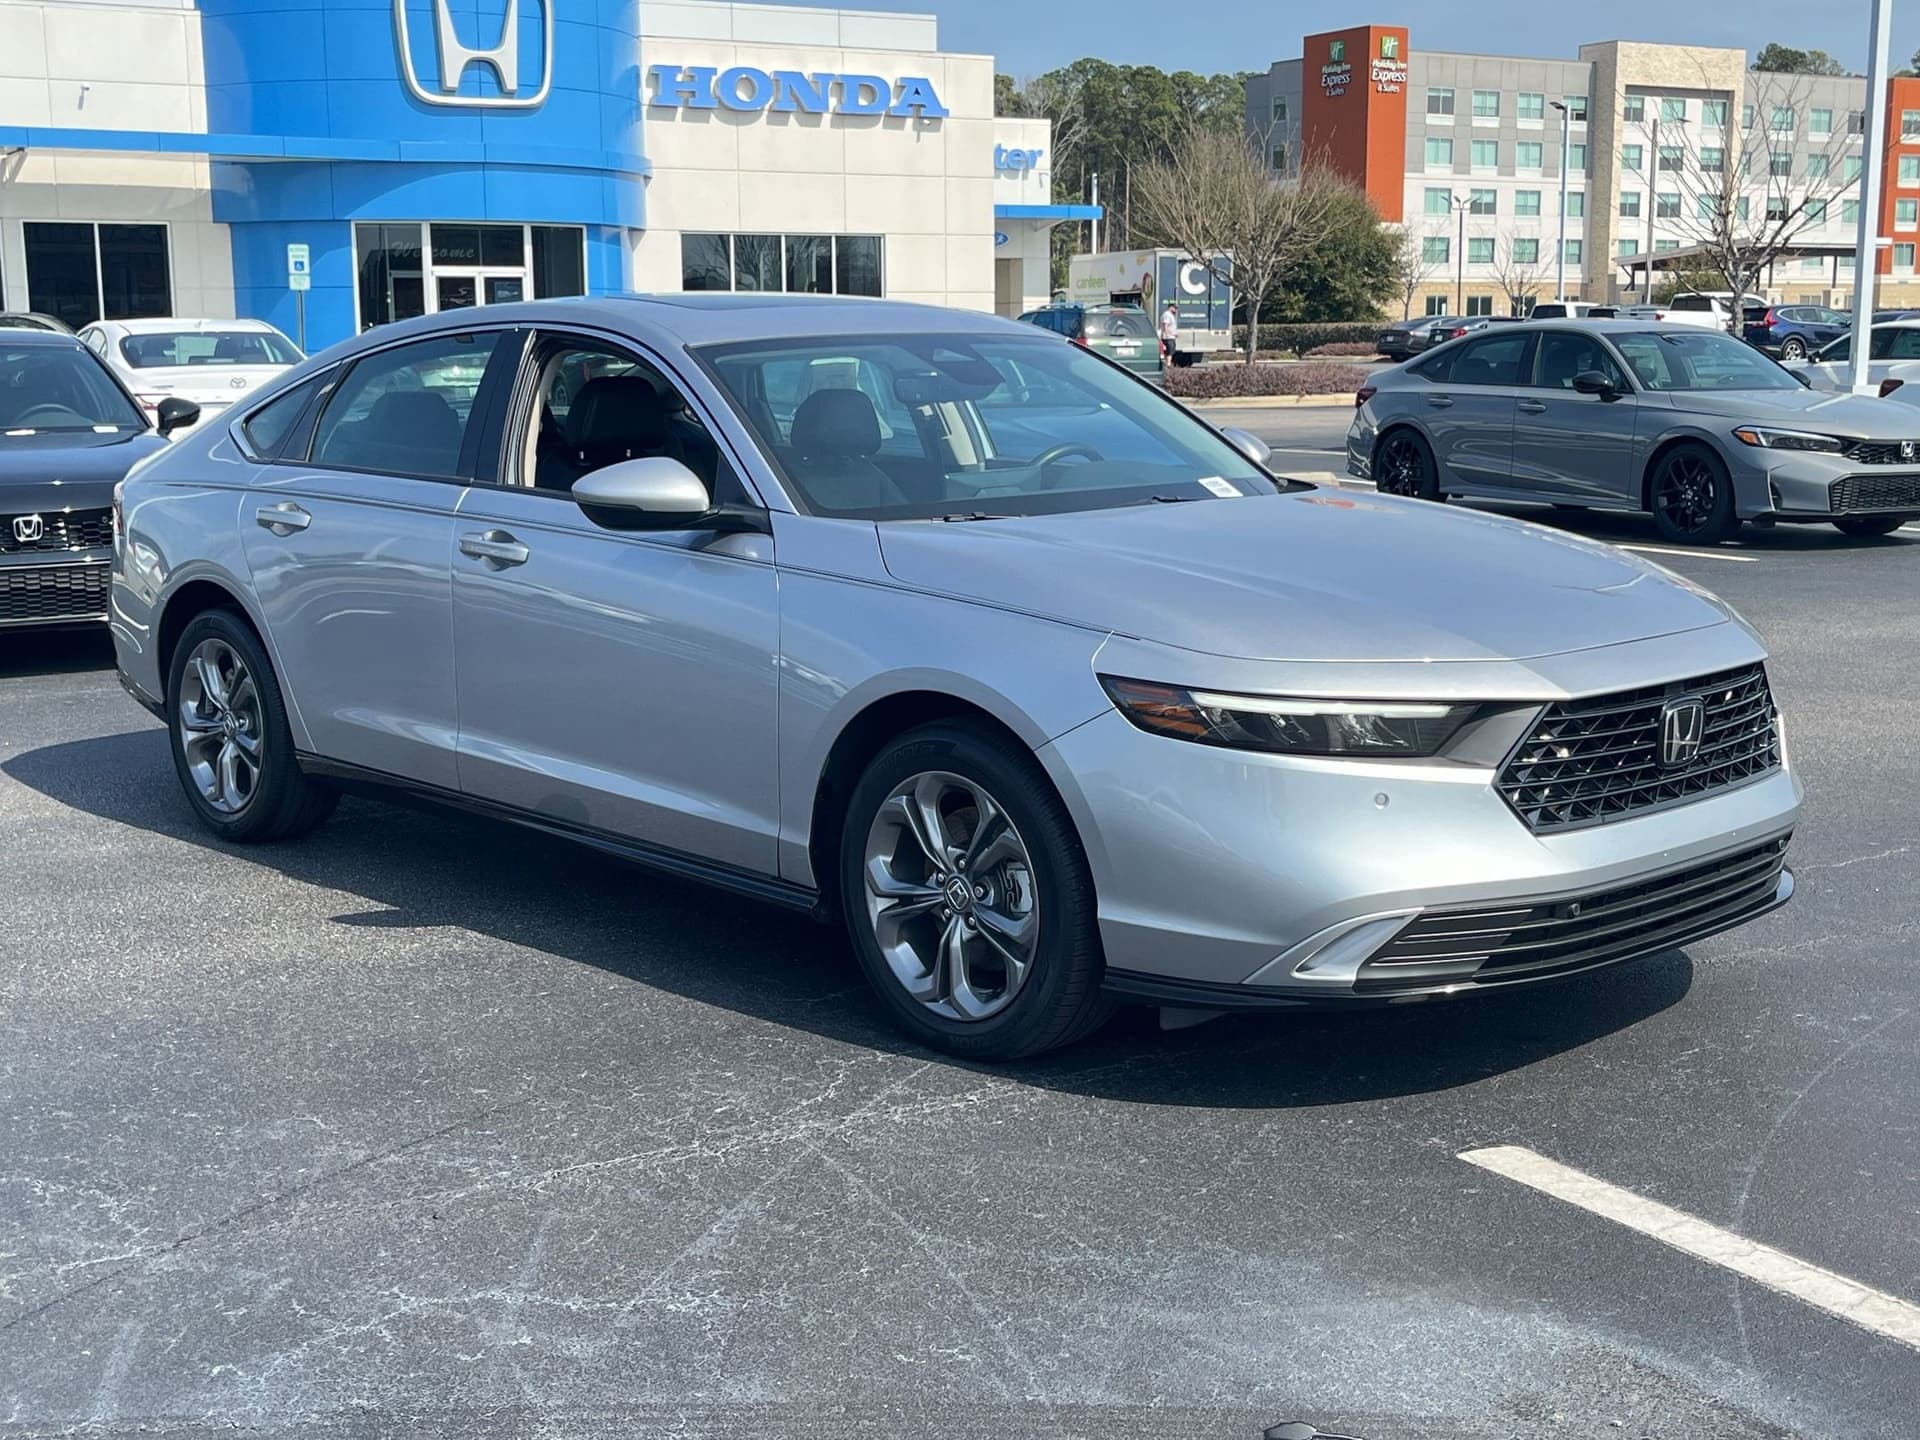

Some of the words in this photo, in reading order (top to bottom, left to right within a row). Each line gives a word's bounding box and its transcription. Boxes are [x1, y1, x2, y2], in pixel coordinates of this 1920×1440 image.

[1372, 58, 1396, 71] Holiday
[1321, 73, 1351, 88] Express
[1372, 68, 1407, 84] Express
[647, 64, 950, 118] HONDA
[1181, 261, 1207, 295] C
